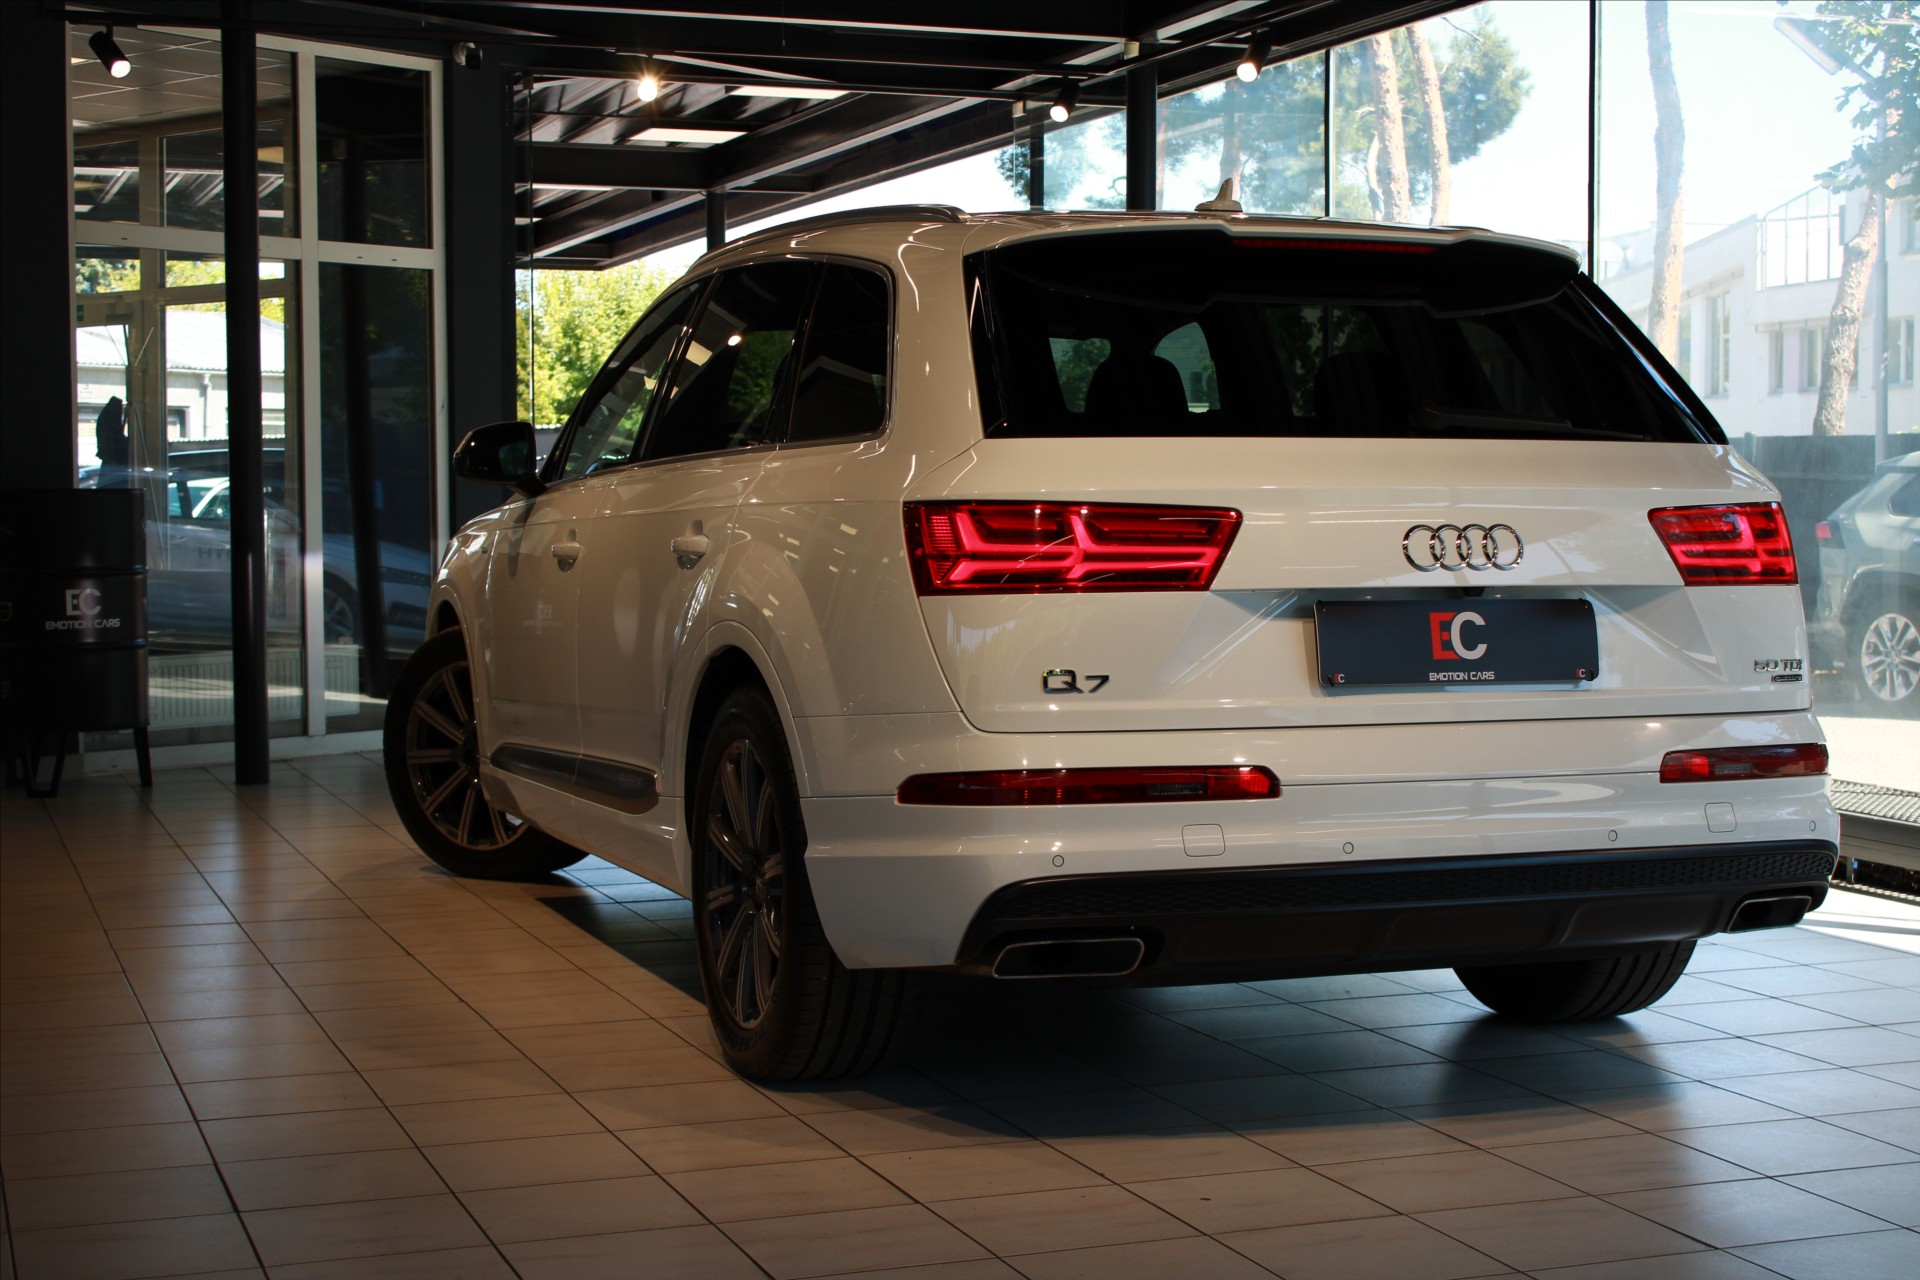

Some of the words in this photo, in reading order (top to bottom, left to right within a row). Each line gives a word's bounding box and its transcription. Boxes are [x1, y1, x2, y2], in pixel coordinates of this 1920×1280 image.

[65, 588, 102, 616] EC
[45, 620, 92, 630] EMOTION
[94, 618, 121, 628] CARS
[1429, 611, 1488, 660] EC
[1754, 659, 1779, 671] 50
[1780, 659, 1803, 671] TDI
[1043, 669, 1110, 694] Q7
[1334, 673, 1345, 683] EC
[1429, 671, 1468, 681] EMOTION
[1470, 671, 1495, 680] CARS
